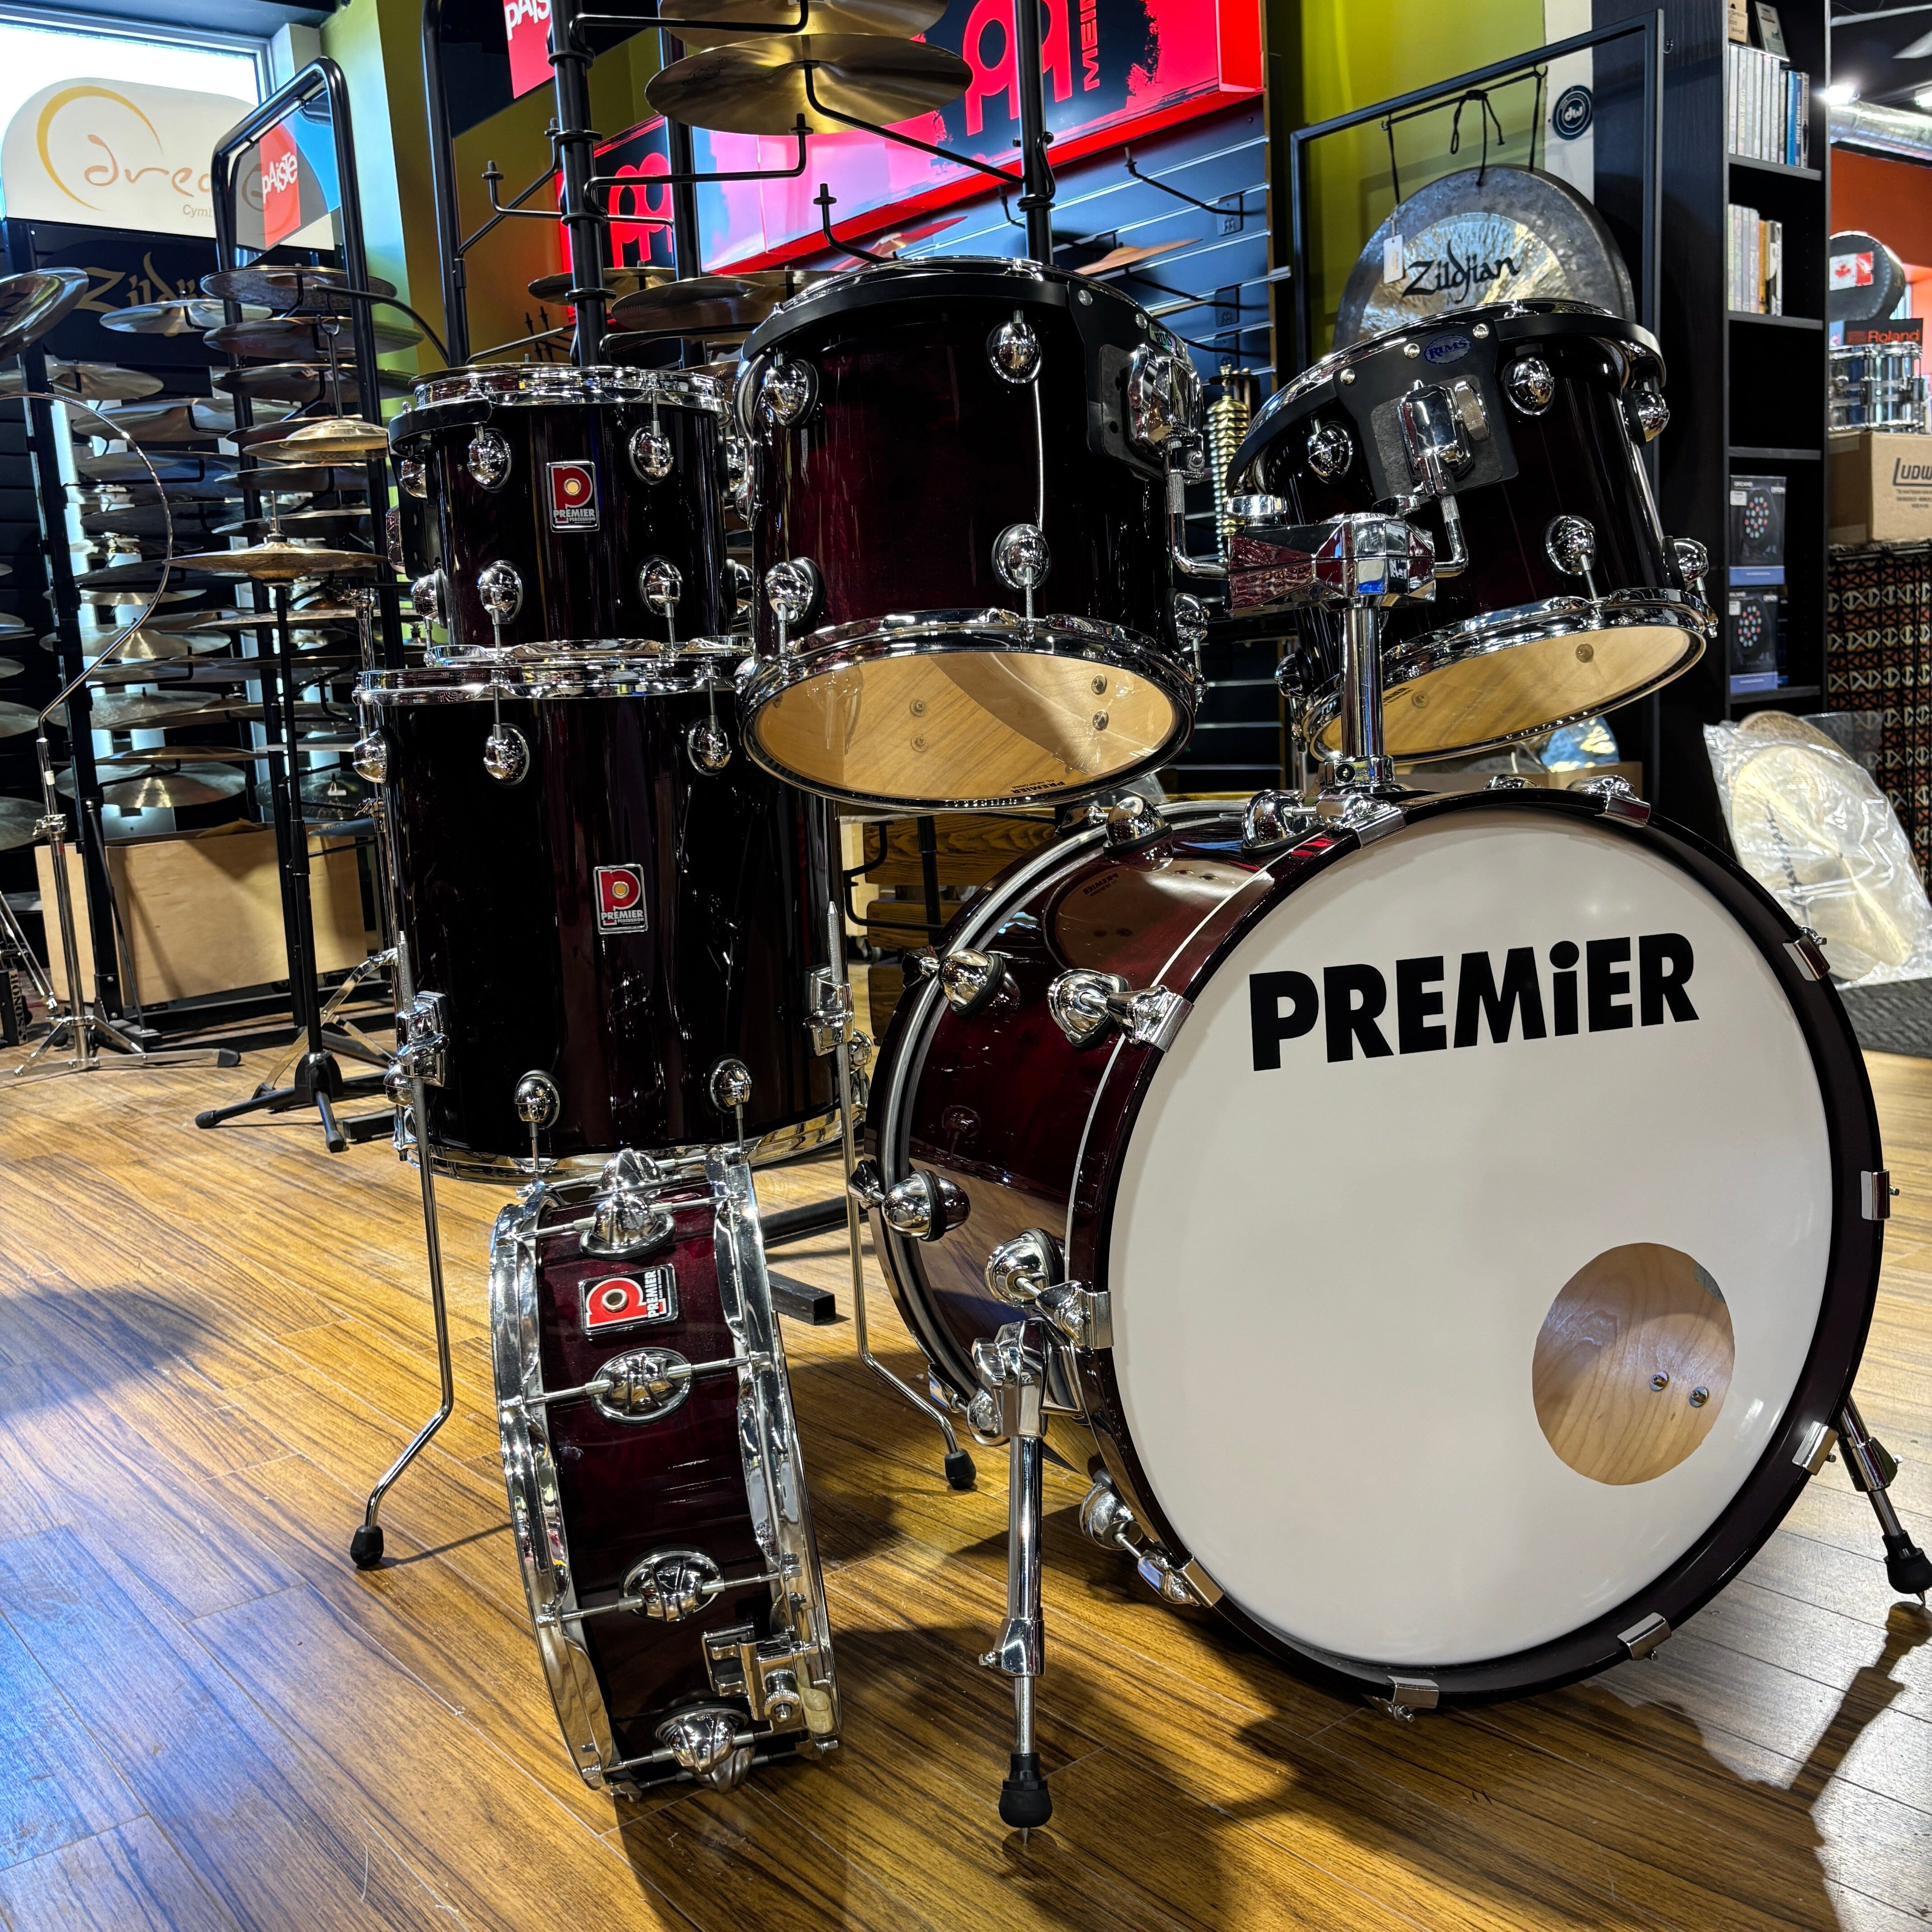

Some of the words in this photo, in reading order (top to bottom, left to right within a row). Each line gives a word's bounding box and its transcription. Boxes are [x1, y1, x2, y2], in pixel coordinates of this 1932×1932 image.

[1402, 239, 1520, 304] Zildjian
[1868, 329, 1920, 344] Roland
[1429, 341, 1467, 359] RIMS
[1010, 781, 1066, 794] PREMIER
[10, 973, 24, 1027] SONOR
